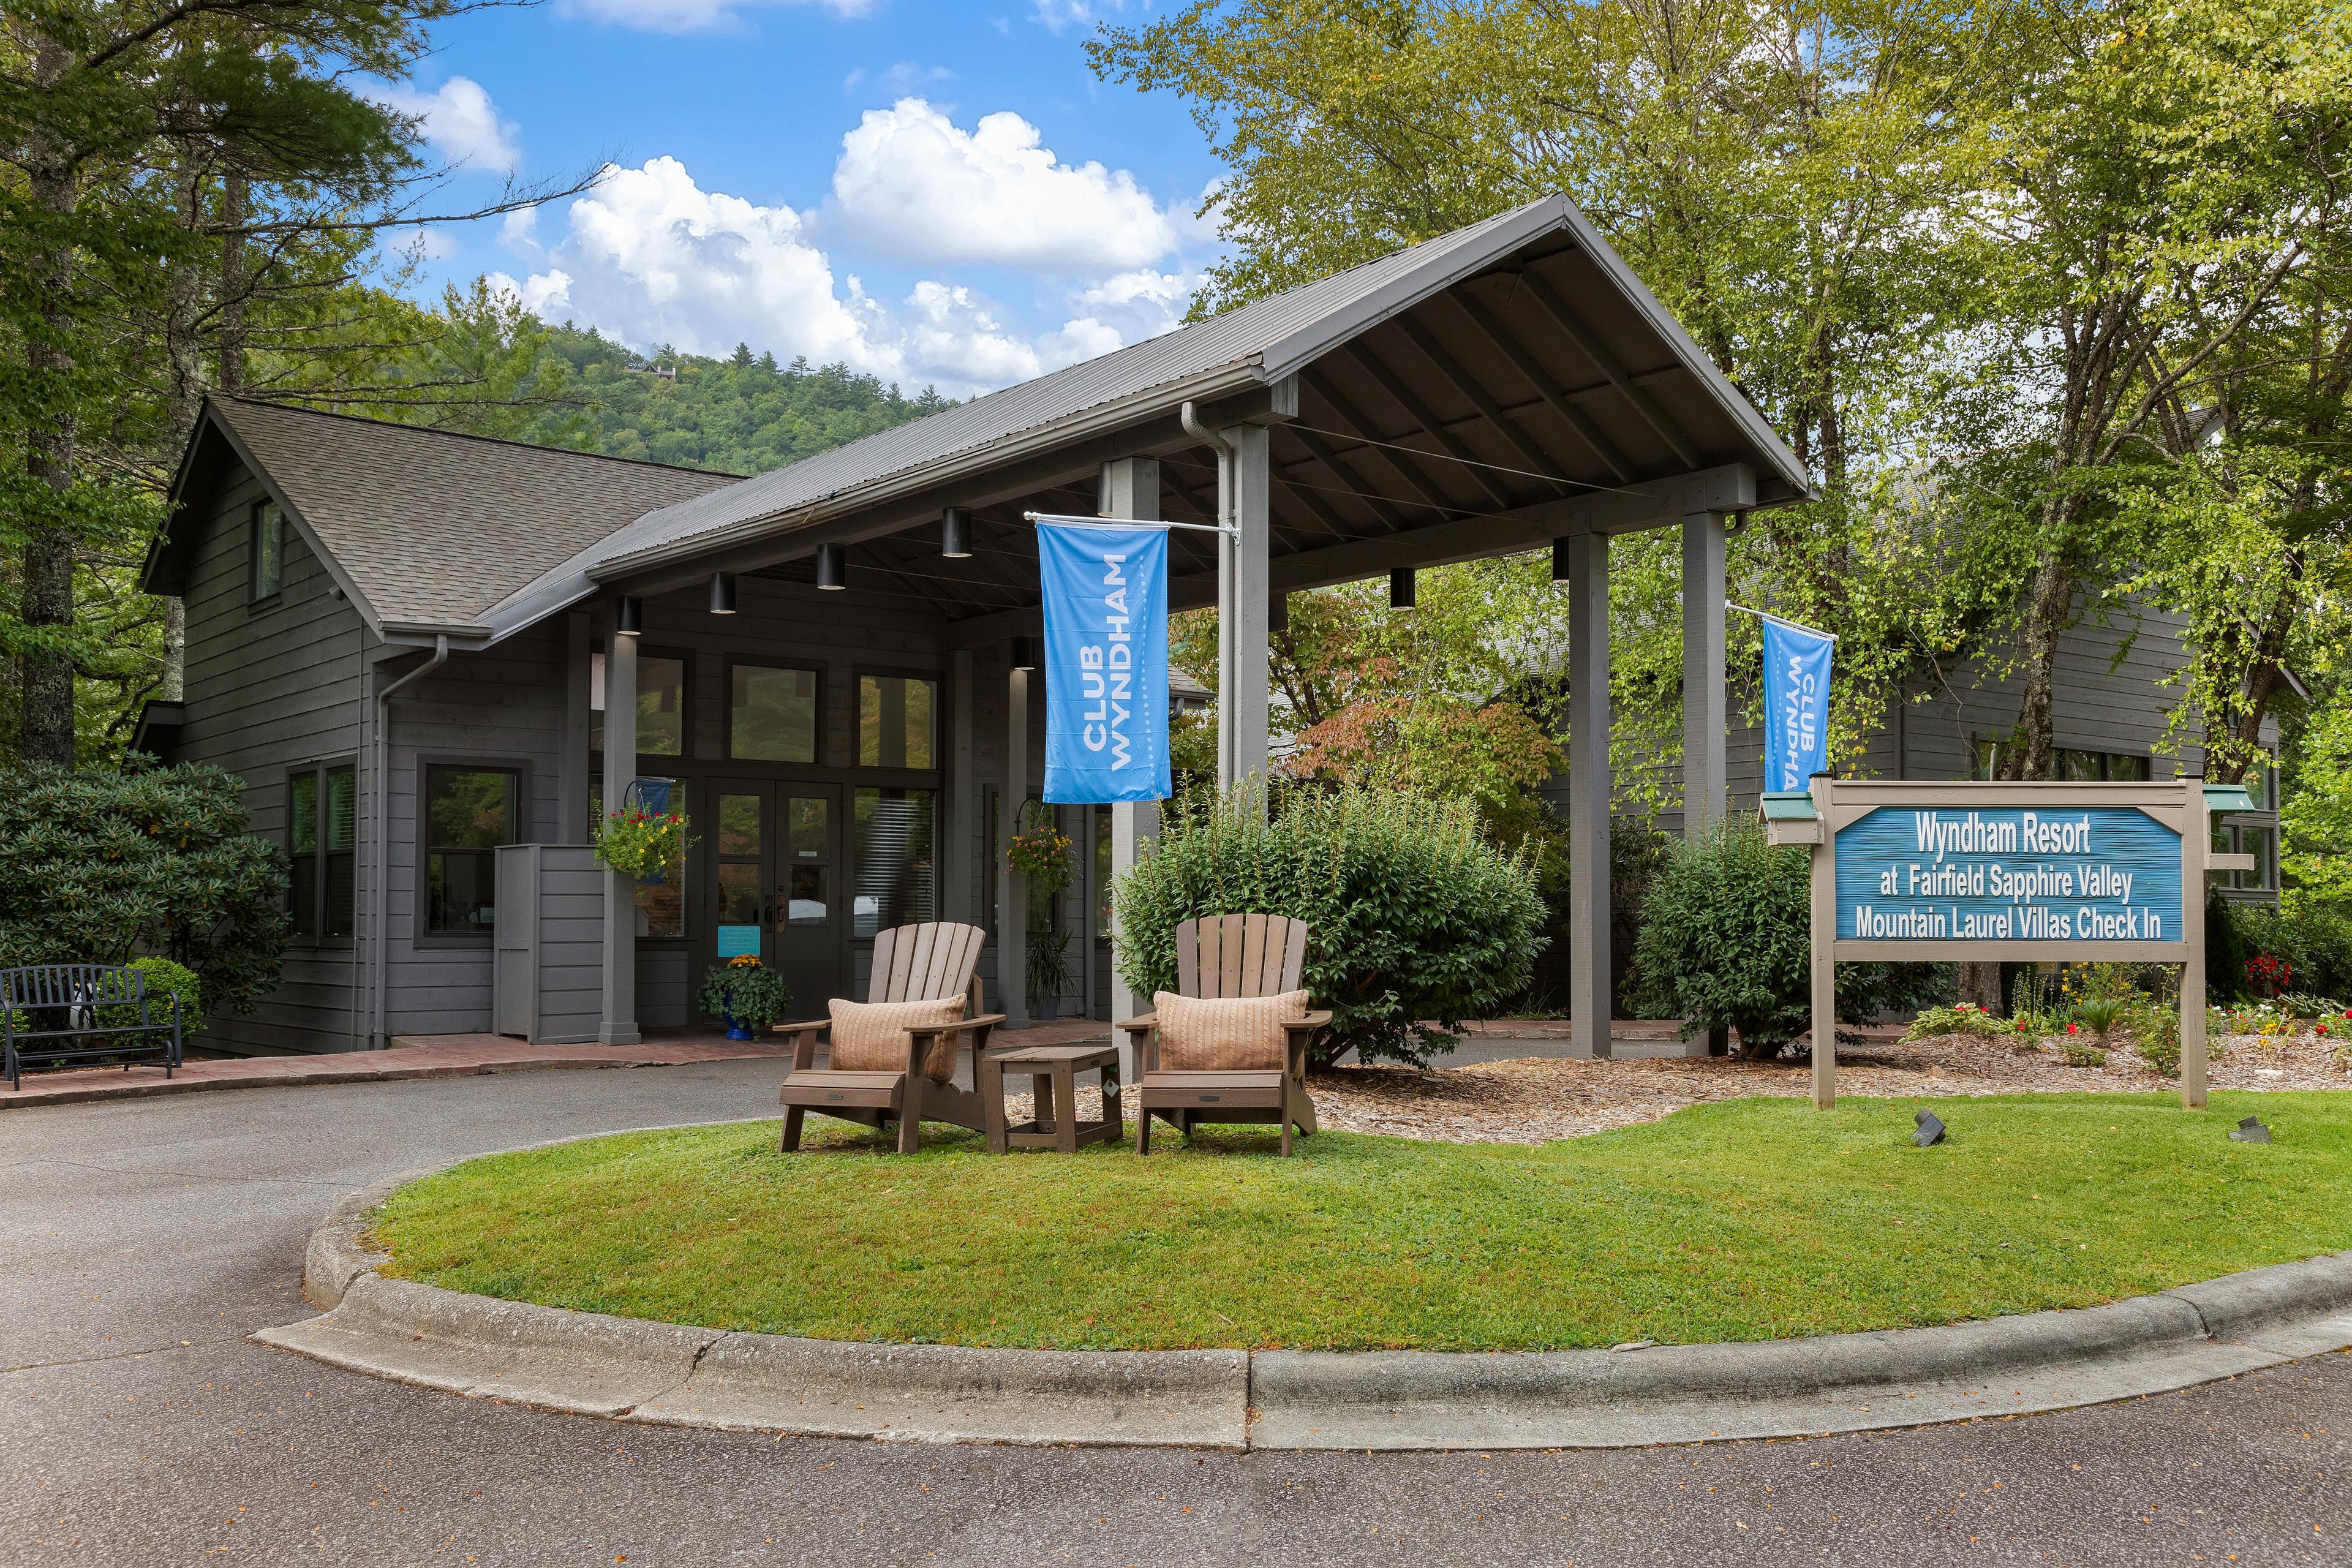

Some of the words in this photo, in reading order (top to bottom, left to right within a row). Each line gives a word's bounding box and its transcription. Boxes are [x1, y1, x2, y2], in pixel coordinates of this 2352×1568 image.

[1080, 645, 1107, 752] CLUB
[1104, 554, 1132, 772] WYNDHAM
[1784, 656, 1802, 791] WYNDHA
[1800, 673, 1815, 752] CLUB
[1915, 812, 2017, 862] Wyndham
[2023, 812, 2090, 853] Resort
[1856, 906, 1946, 938] Mountain
[1952, 907, 2013, 938] Laurel
[2018, 907, 2071, 939] Villas
[2077, 907, 2138, 939] Check
[2143, 907, 2162, 938] In
[1880, 867, 1898, 896] at
[1909, 864, 1985, 896] Fairfield
[1989, 864, 2073, 904] Sapphire
[2078, 864, 2133, 905] Valley
